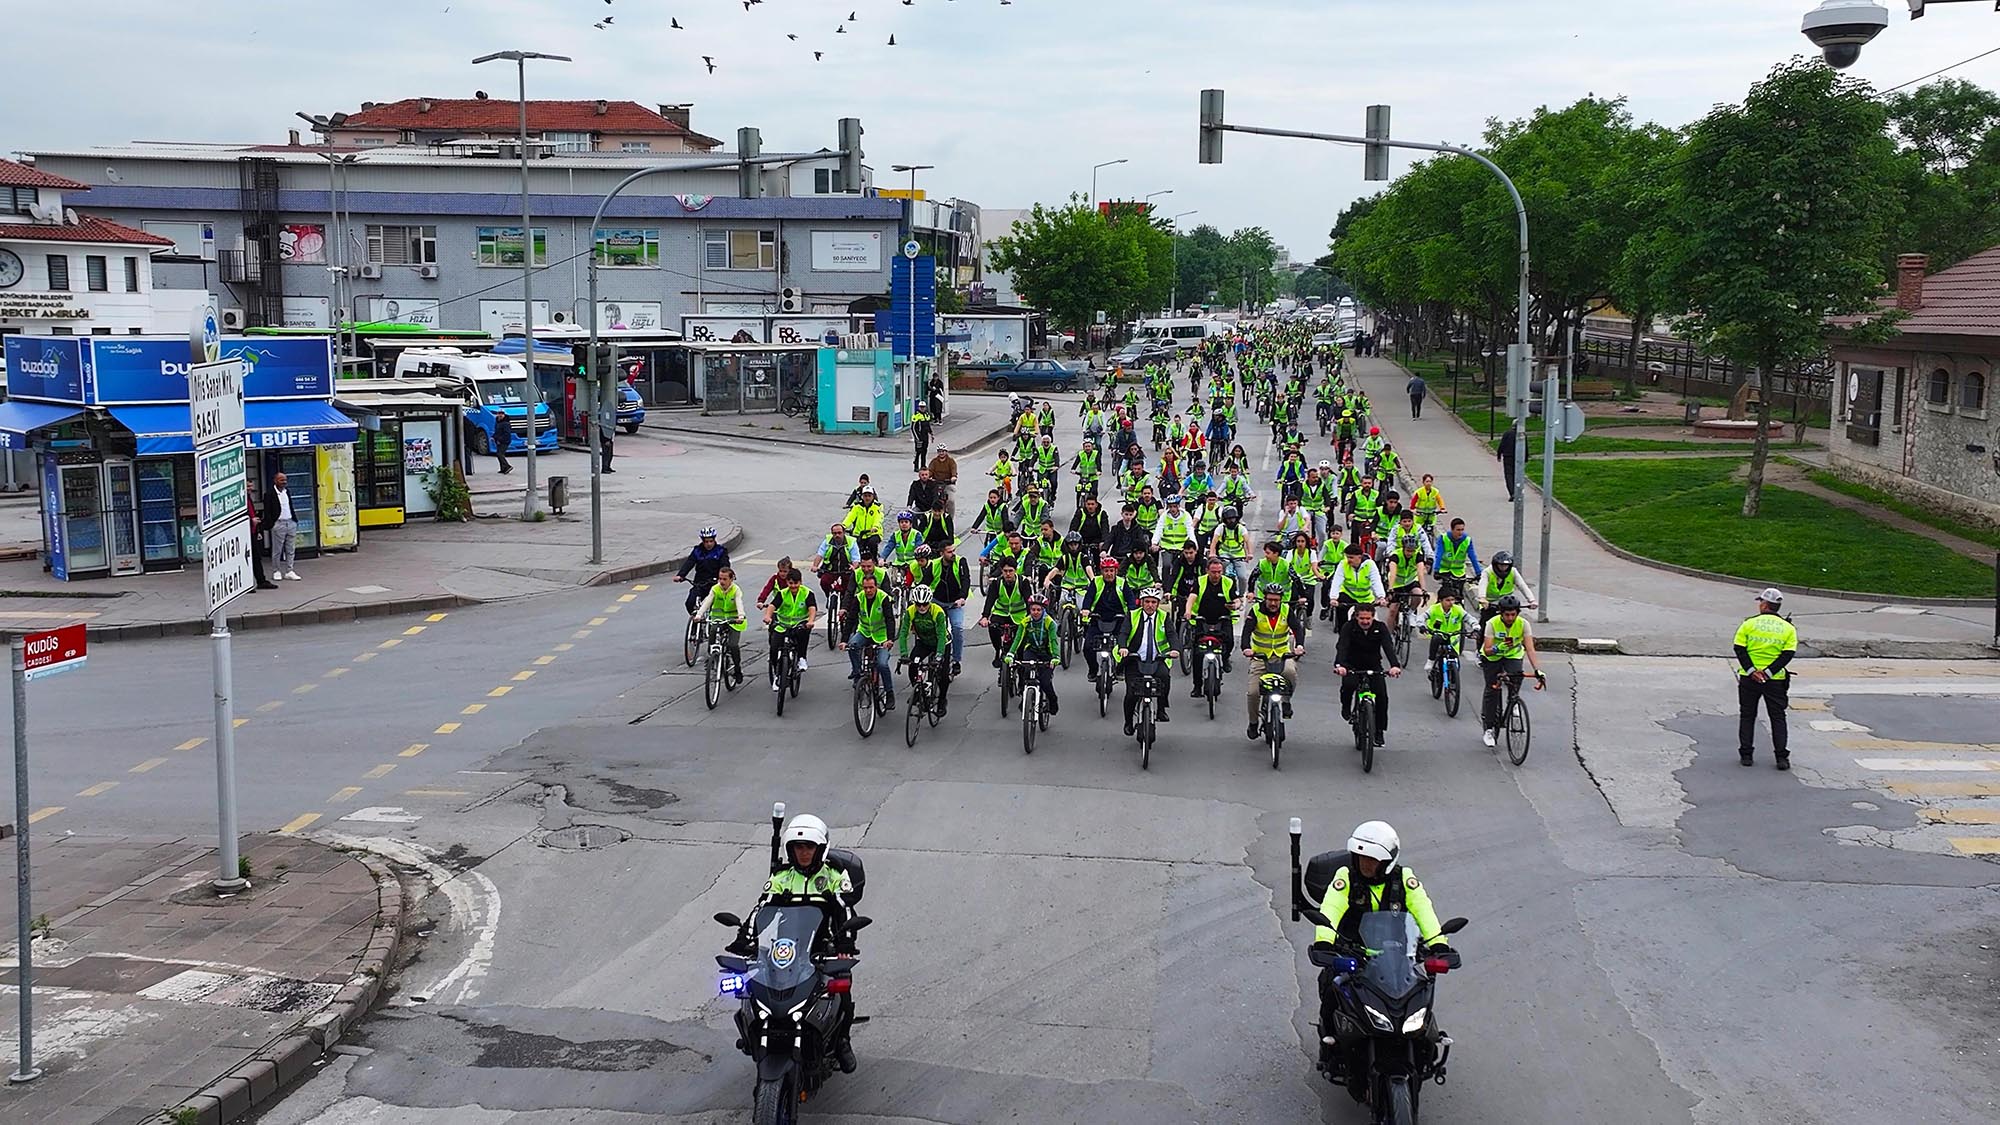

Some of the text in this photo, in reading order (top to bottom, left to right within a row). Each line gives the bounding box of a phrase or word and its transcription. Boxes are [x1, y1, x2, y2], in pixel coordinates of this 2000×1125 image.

[0, 309, 38, 317] REKET
[20, 358, 58, 378] buzdağı
[196, 401, 221, 439] SASKİ
[261, 430, 310, 447] BÜFE
[207, 536, 240, 572] Serdivan
[27, 635, 59, 655] KUDÜS
[27, 655, 52, 667] CADDESİ
